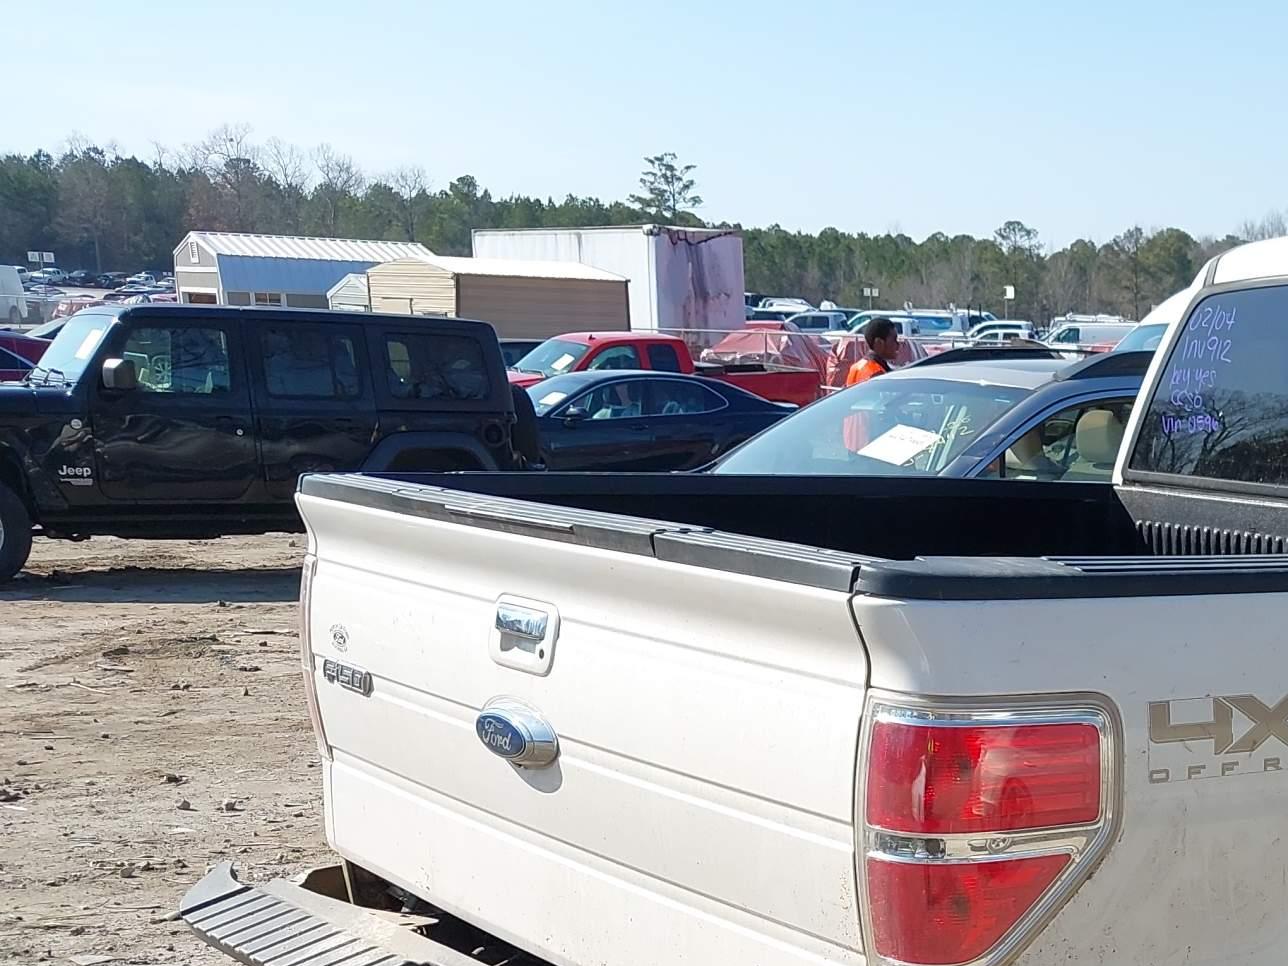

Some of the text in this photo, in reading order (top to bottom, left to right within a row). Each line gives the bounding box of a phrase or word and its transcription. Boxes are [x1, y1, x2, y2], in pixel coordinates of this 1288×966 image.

[1188, 304, 1237, 336] 02/04
[57, 464, 92, 477] Jeep
[481, 717, 513, 752] Ford
[1148, 760, 1240, 784] OFF
